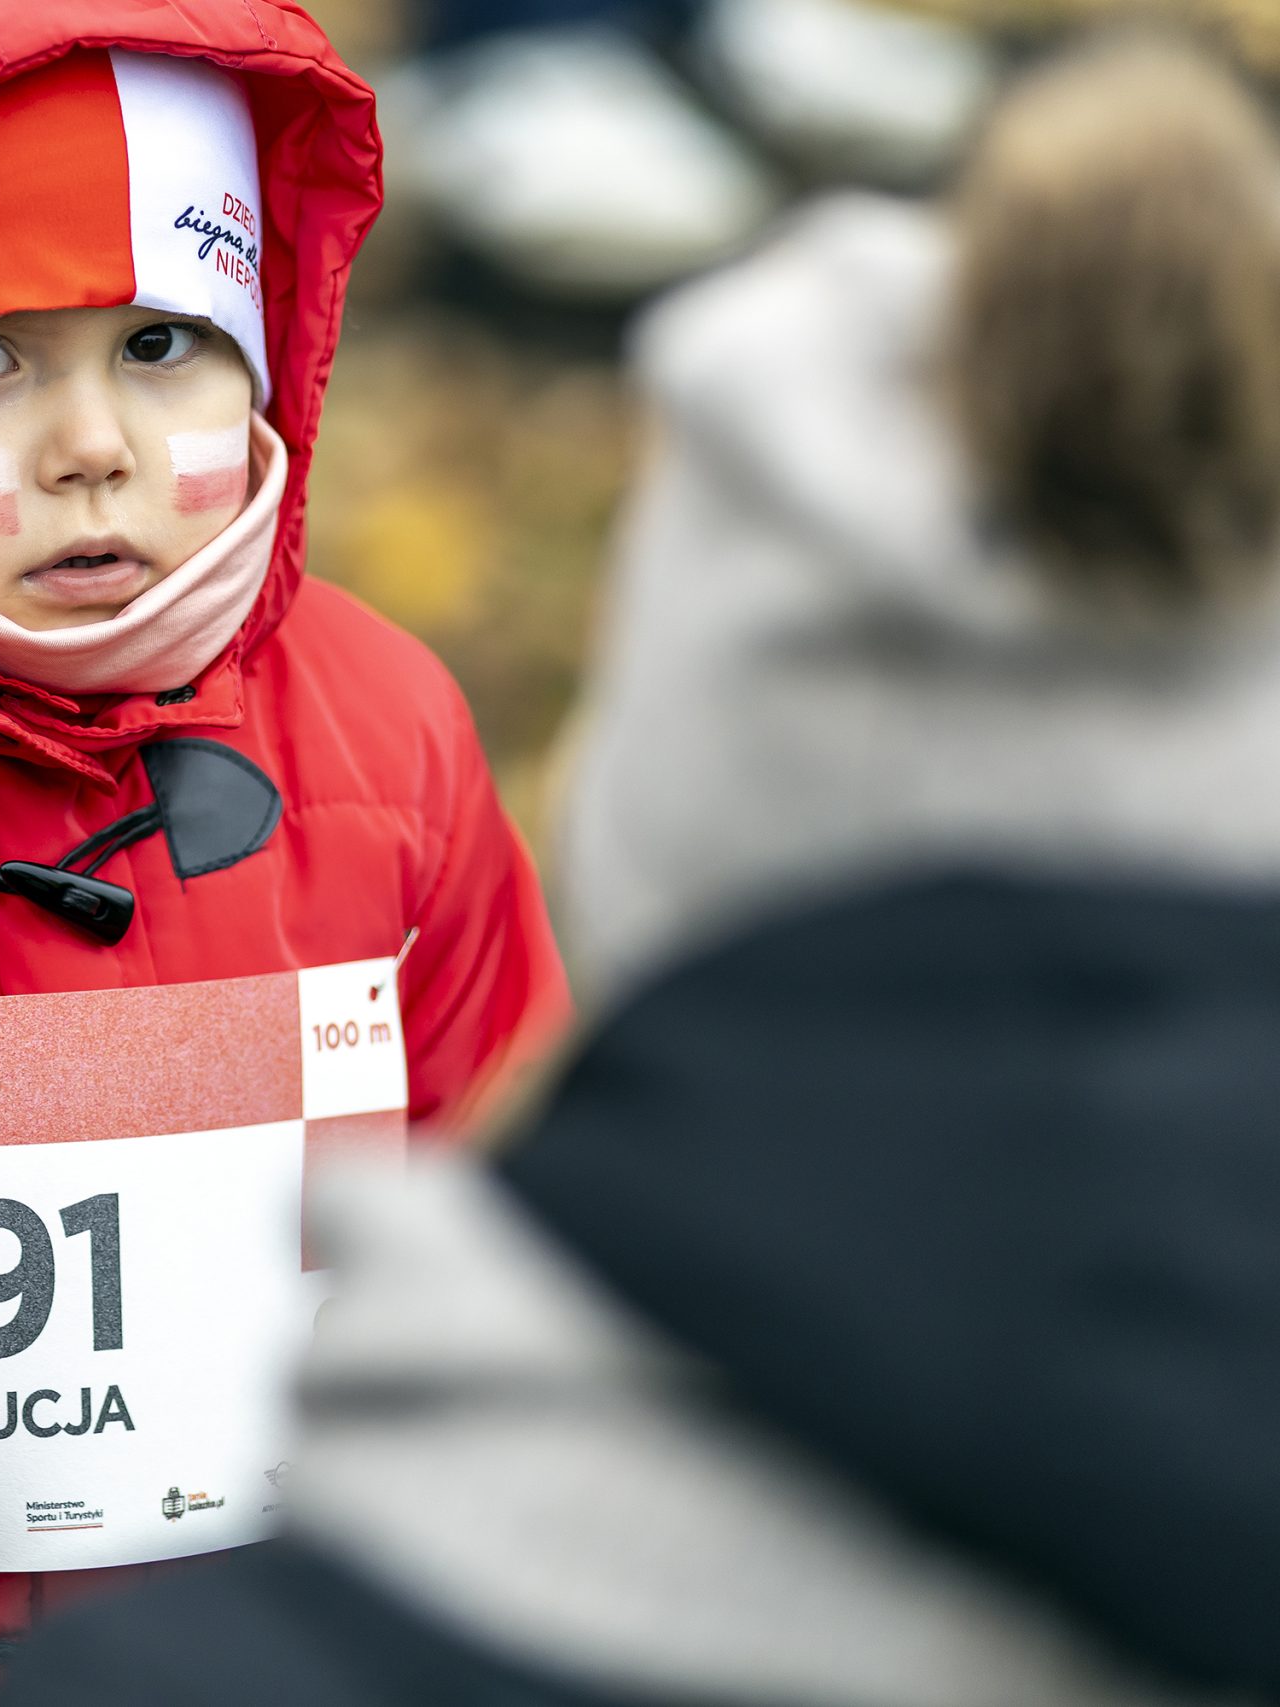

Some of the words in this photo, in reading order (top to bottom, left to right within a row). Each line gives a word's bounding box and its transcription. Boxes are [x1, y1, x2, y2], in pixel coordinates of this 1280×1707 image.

[313, 1020, 359, 1051] 100
[370, 1022, 391, 1043] m
[26, 1501, 85, 1510] Ministerstwo
[26, 1513, 57, 1523] Sportu
[64, 1509, 104, 1520] Turystyki
